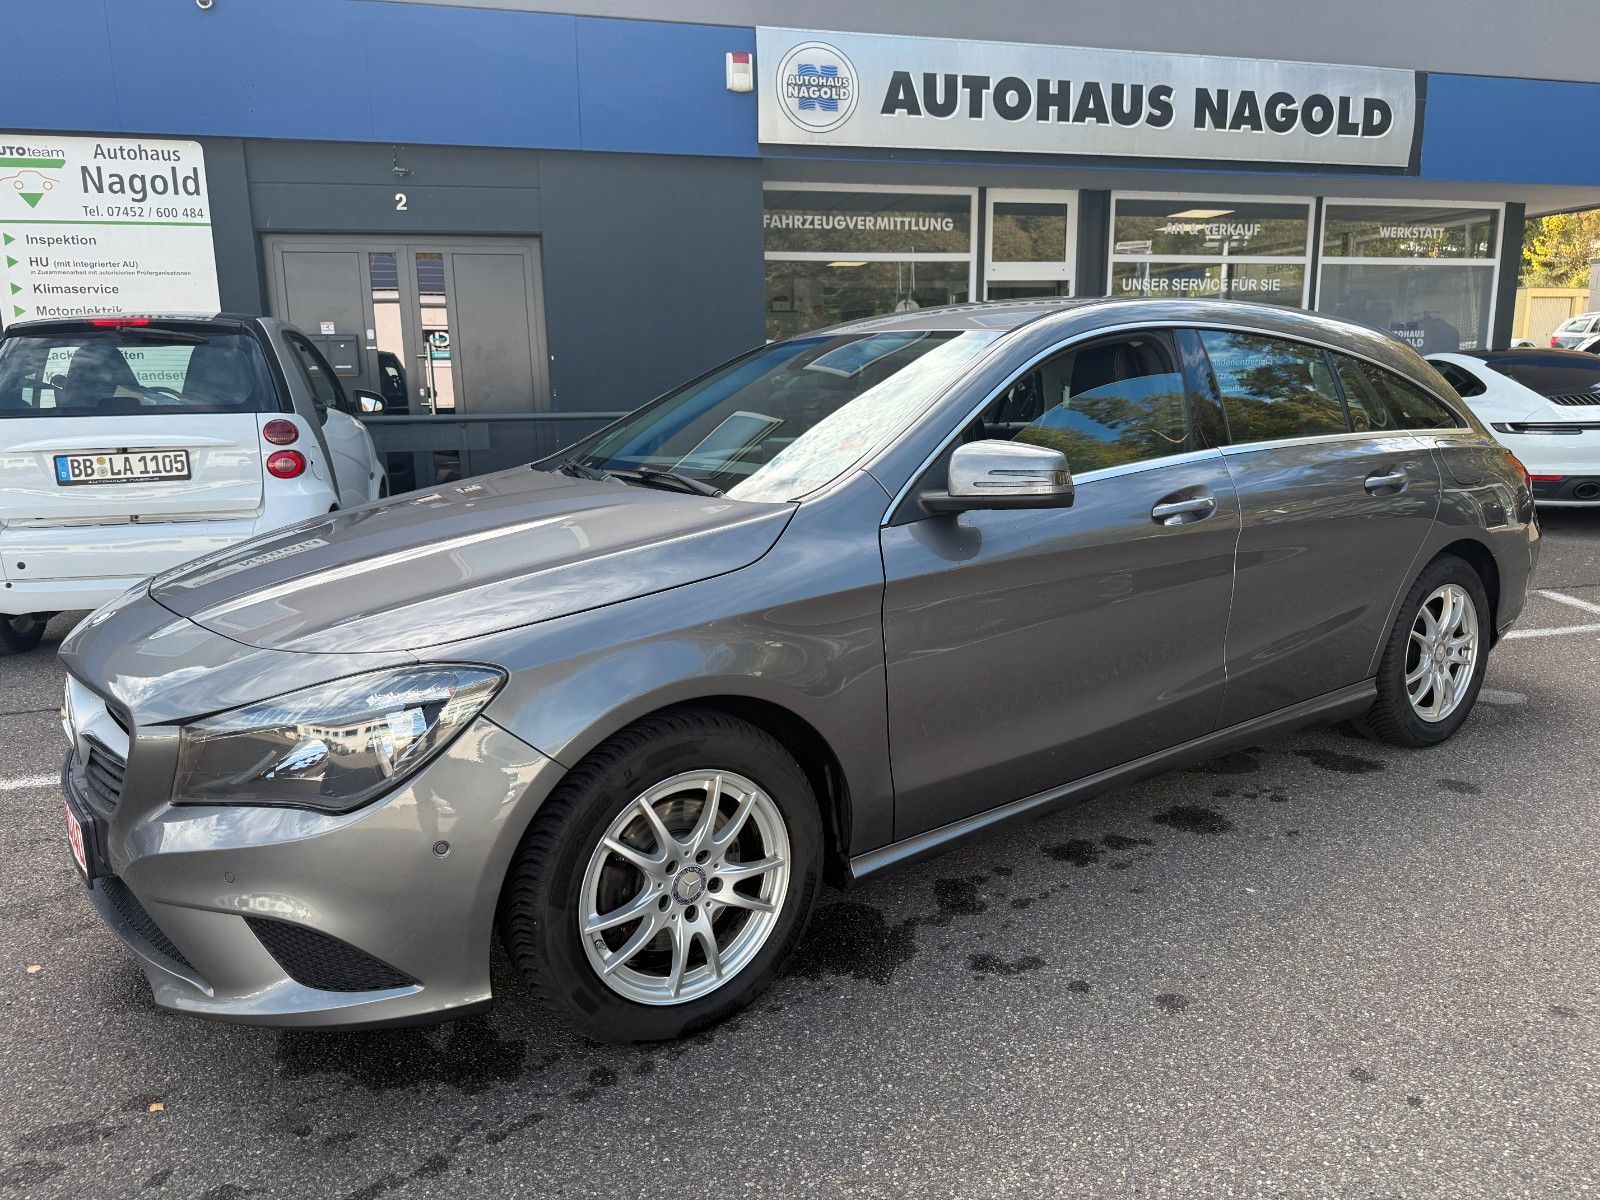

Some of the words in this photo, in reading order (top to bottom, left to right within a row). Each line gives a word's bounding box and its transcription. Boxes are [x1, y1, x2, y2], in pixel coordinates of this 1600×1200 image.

[787, 74, 850, 87] AUTOHAUS
[786, 84, 850, 101] NAGOLD
[880, 70, 1176, 128] AUTOHAUS
[1193, 87, 1394, 138] NAGOLD
[93, 143, 181, 162] Autohaus
[80, 165, 201, 203] Nagold
[394, 193, 408, 211] 2
[82, 205, 104, 217] Tel.
[106, 206, 145, 218] 07452
[156, 207, 178, 218] 600
[182, 207, 204, 218] 484
[763, 214, 954, 231] FAHRZEUGVERMITTLUNG
[1164, 222, 1185, 235] AN
[1204, 223, 1261, 236] VERKAUF
[1379, 226, 1445, 239] WERKSTATT
[25, 234, 97, 247] Inspektion
[29, 256, 49, 267] HU
[53, 260, 71, 268] (mit
[72, 260, 120, 269] integrierter
[122, 260, 139, 269] AU)
[33, 283, 120, 295] Klimaservice
[1122, 278, 1168, 291] UNSER
[1171, 278, 1228, 291] SERVICE
[1231, 276, 1258, 291] FÜR
[1259, 278, 1281, 291] SIE
[71, 459, 96, 478] BB
[109, 457, 134, 476] LA
[138, 454, 185, 474] 1105
